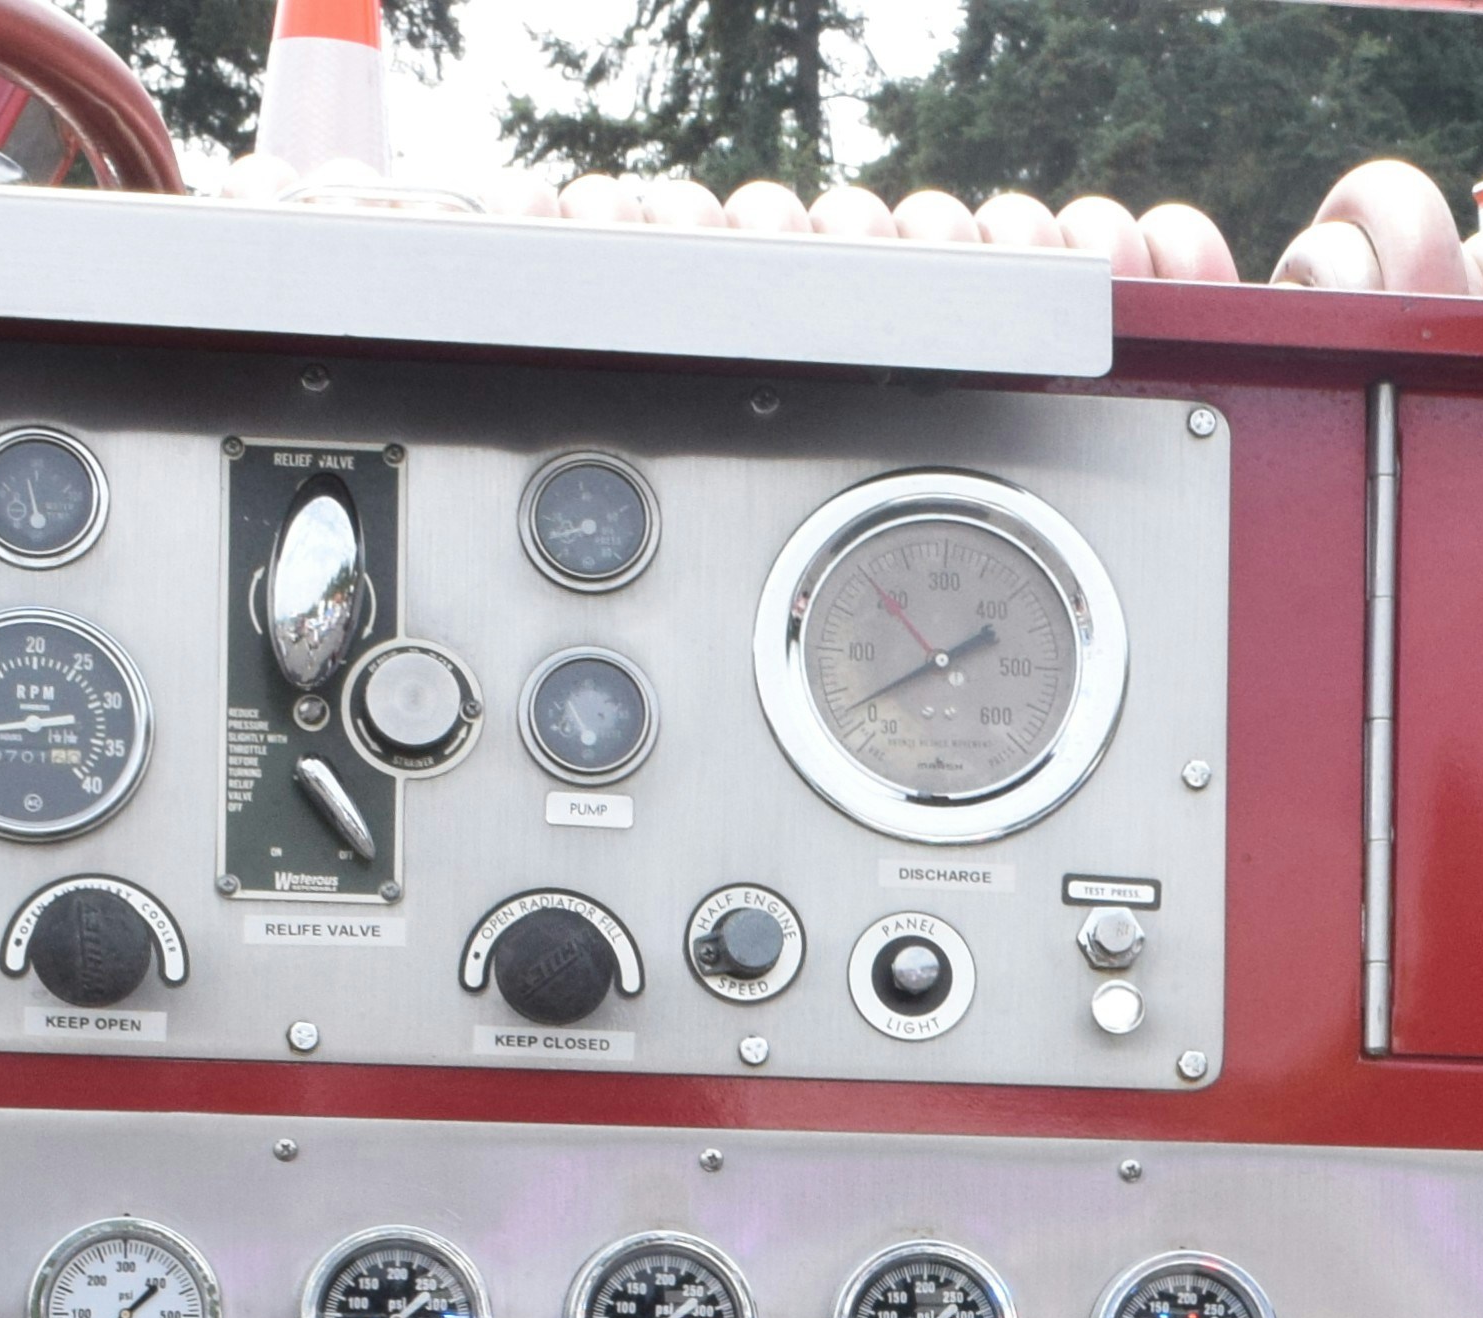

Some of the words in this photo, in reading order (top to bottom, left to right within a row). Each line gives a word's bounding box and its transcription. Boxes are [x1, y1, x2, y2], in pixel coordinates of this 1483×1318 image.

[274, 453, 313, 469] RELIEF
[26, 637, 45, 653] 20
[74, 654, 93, 670] 25
[17, 685, 55, 700] RPM
[103, 693, 122, 709] 30
[105, 740, 125, 757] 35
[82, 776, 102, 794] 40
[570, 803, 607, 816] PUMP
[898, 867, 992, 884] DISCHARGE
[1083, 887, 1106, 897] TEST
[480, 908, 515, 939] OPEN
[518, 894, 595, 921] RADIATOR
[597, 911, 622, 943] FILL
[697, 894, 734, 930] HALF
[744, 892, 797, 941] ENGINE
[266, 924, 322, 936] RELIFE
[327, 925, 381, 937] VALVE
[881, 920, 937, 937] PANEL
[717, 977, 769, 996] SPEED
[46, 1016, 89, 1030] KEEP
[94, 1018, 141, 1031] OPEN
[886, 1017, 941, 1035] LIGHT
[494, 1034, 537, 1049] KEEP
[542, 1036, 610, 1052] CLOSED
